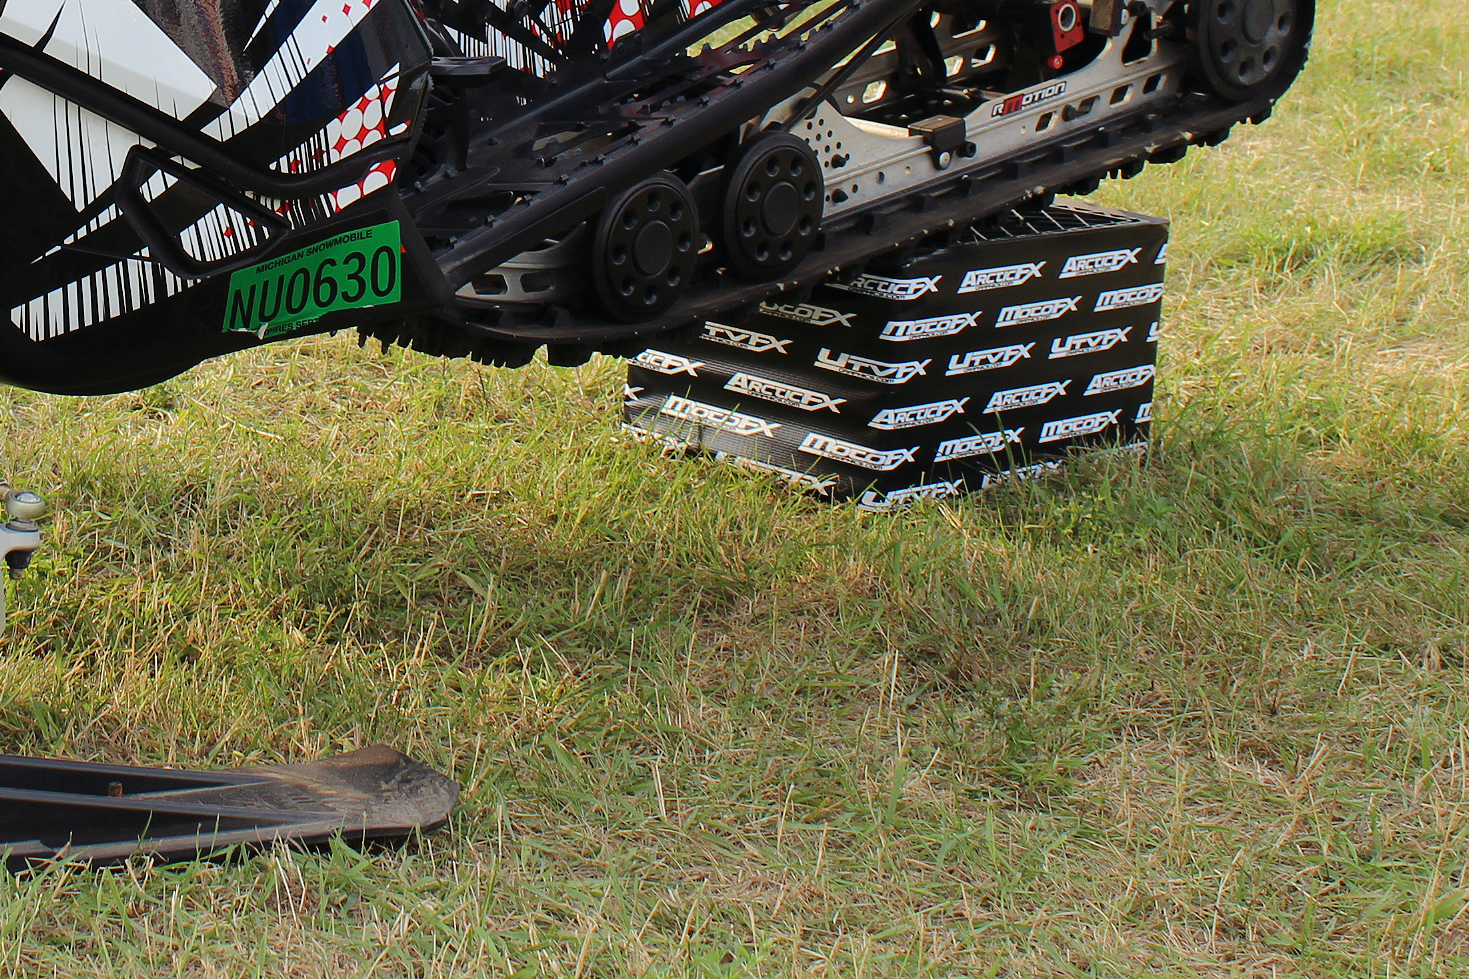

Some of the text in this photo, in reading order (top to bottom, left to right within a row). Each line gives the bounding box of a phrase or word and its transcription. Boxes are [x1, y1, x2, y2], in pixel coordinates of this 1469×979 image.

[991, 81, 1067, 117] RMOTION
[256, 229, 373, 275] MICHIGAN SNOWMOBILE
[1060, 247, 1142, 274] ARCTICFX
[232, 245, 397, 330] NU0630
[850, 273, 943, 297] RCTICFX
[960, 261, 1046, 289] ARCTICFX
[1050, 326, 1133, 355] UTVFX
[816, 348, 932, 378] UTVFX
[948, 342, 1036, 371] UTVFX
[725, 372, 849, 413] ARCTICFX
[985, 379, 1072, 408] ARCTICFX
[870, 397, 971, 424] ARCTICFX
